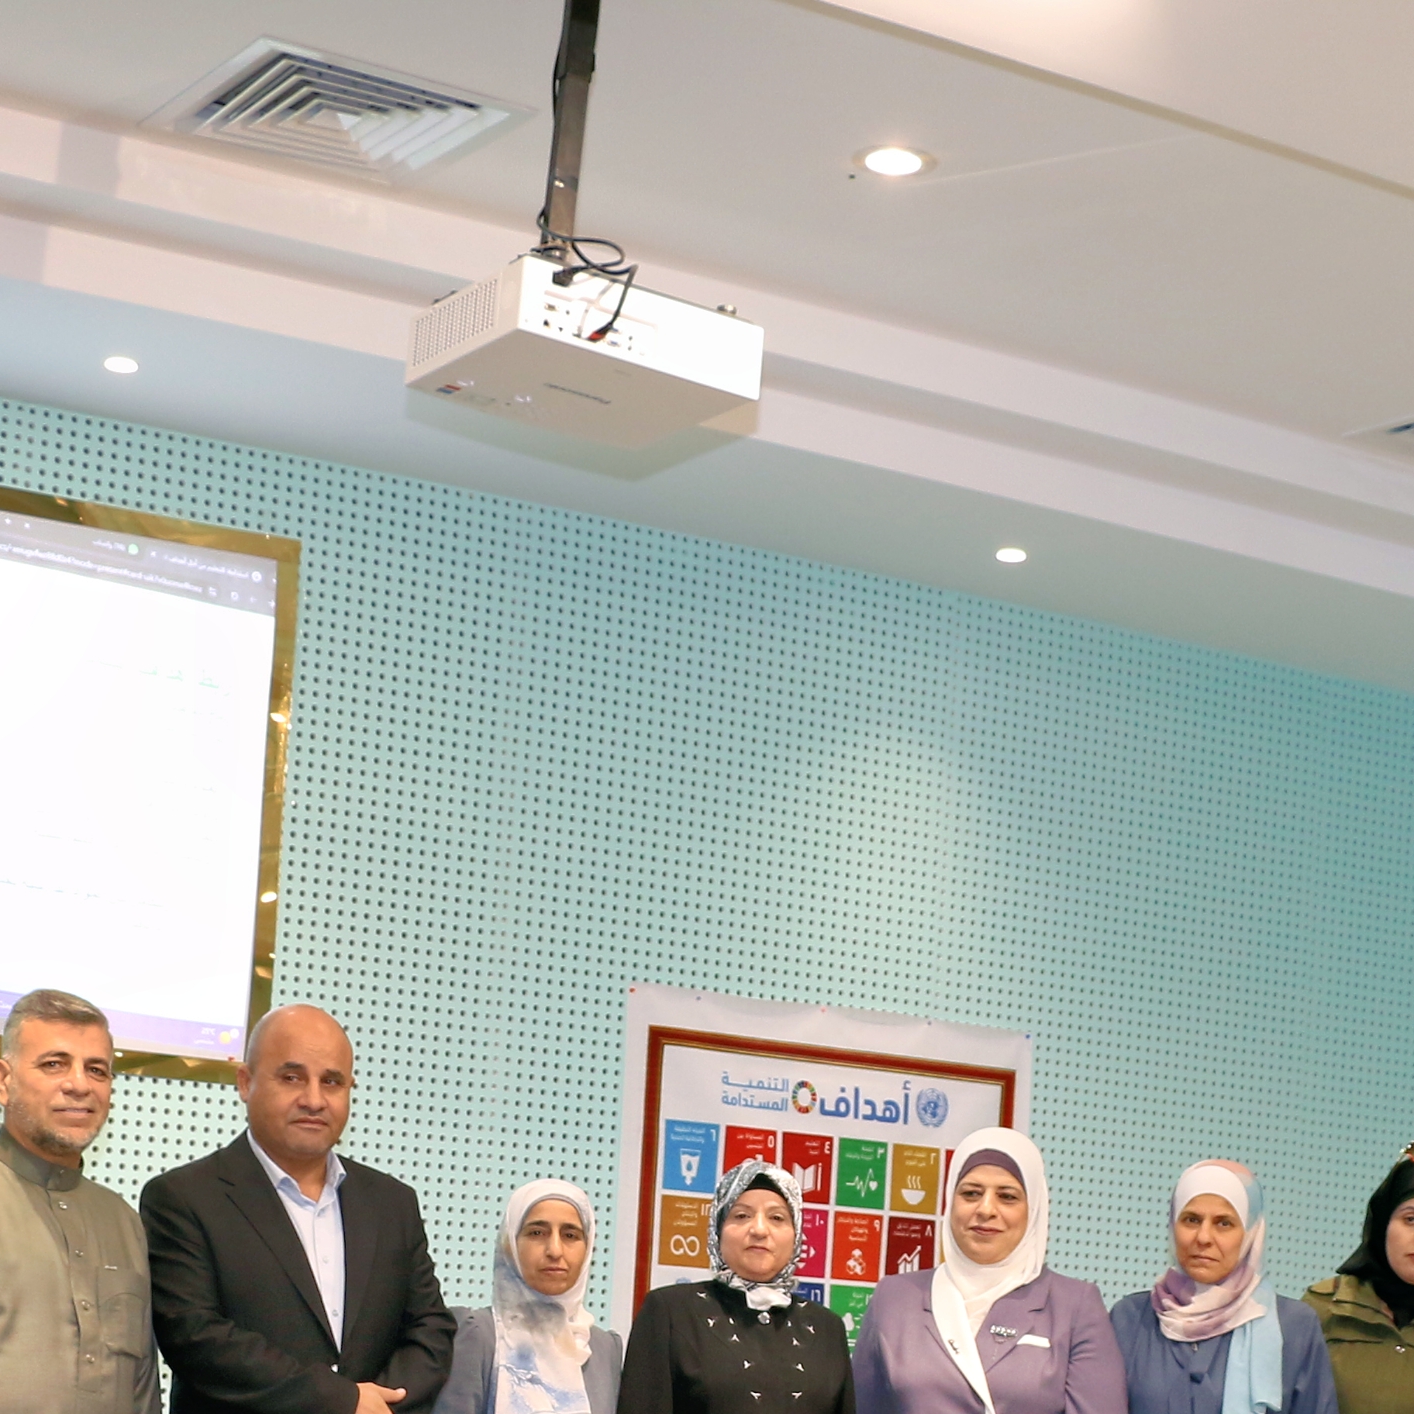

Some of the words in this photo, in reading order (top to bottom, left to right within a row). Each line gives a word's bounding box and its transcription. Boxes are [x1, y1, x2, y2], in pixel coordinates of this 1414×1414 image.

[721, 1071, 789, 1092] التنمية
[721, 1090, 788, 1112] المستدامة
[819, 1080, 911, 1125] أهداف
[824, 1141, 831, 1154] ٤
